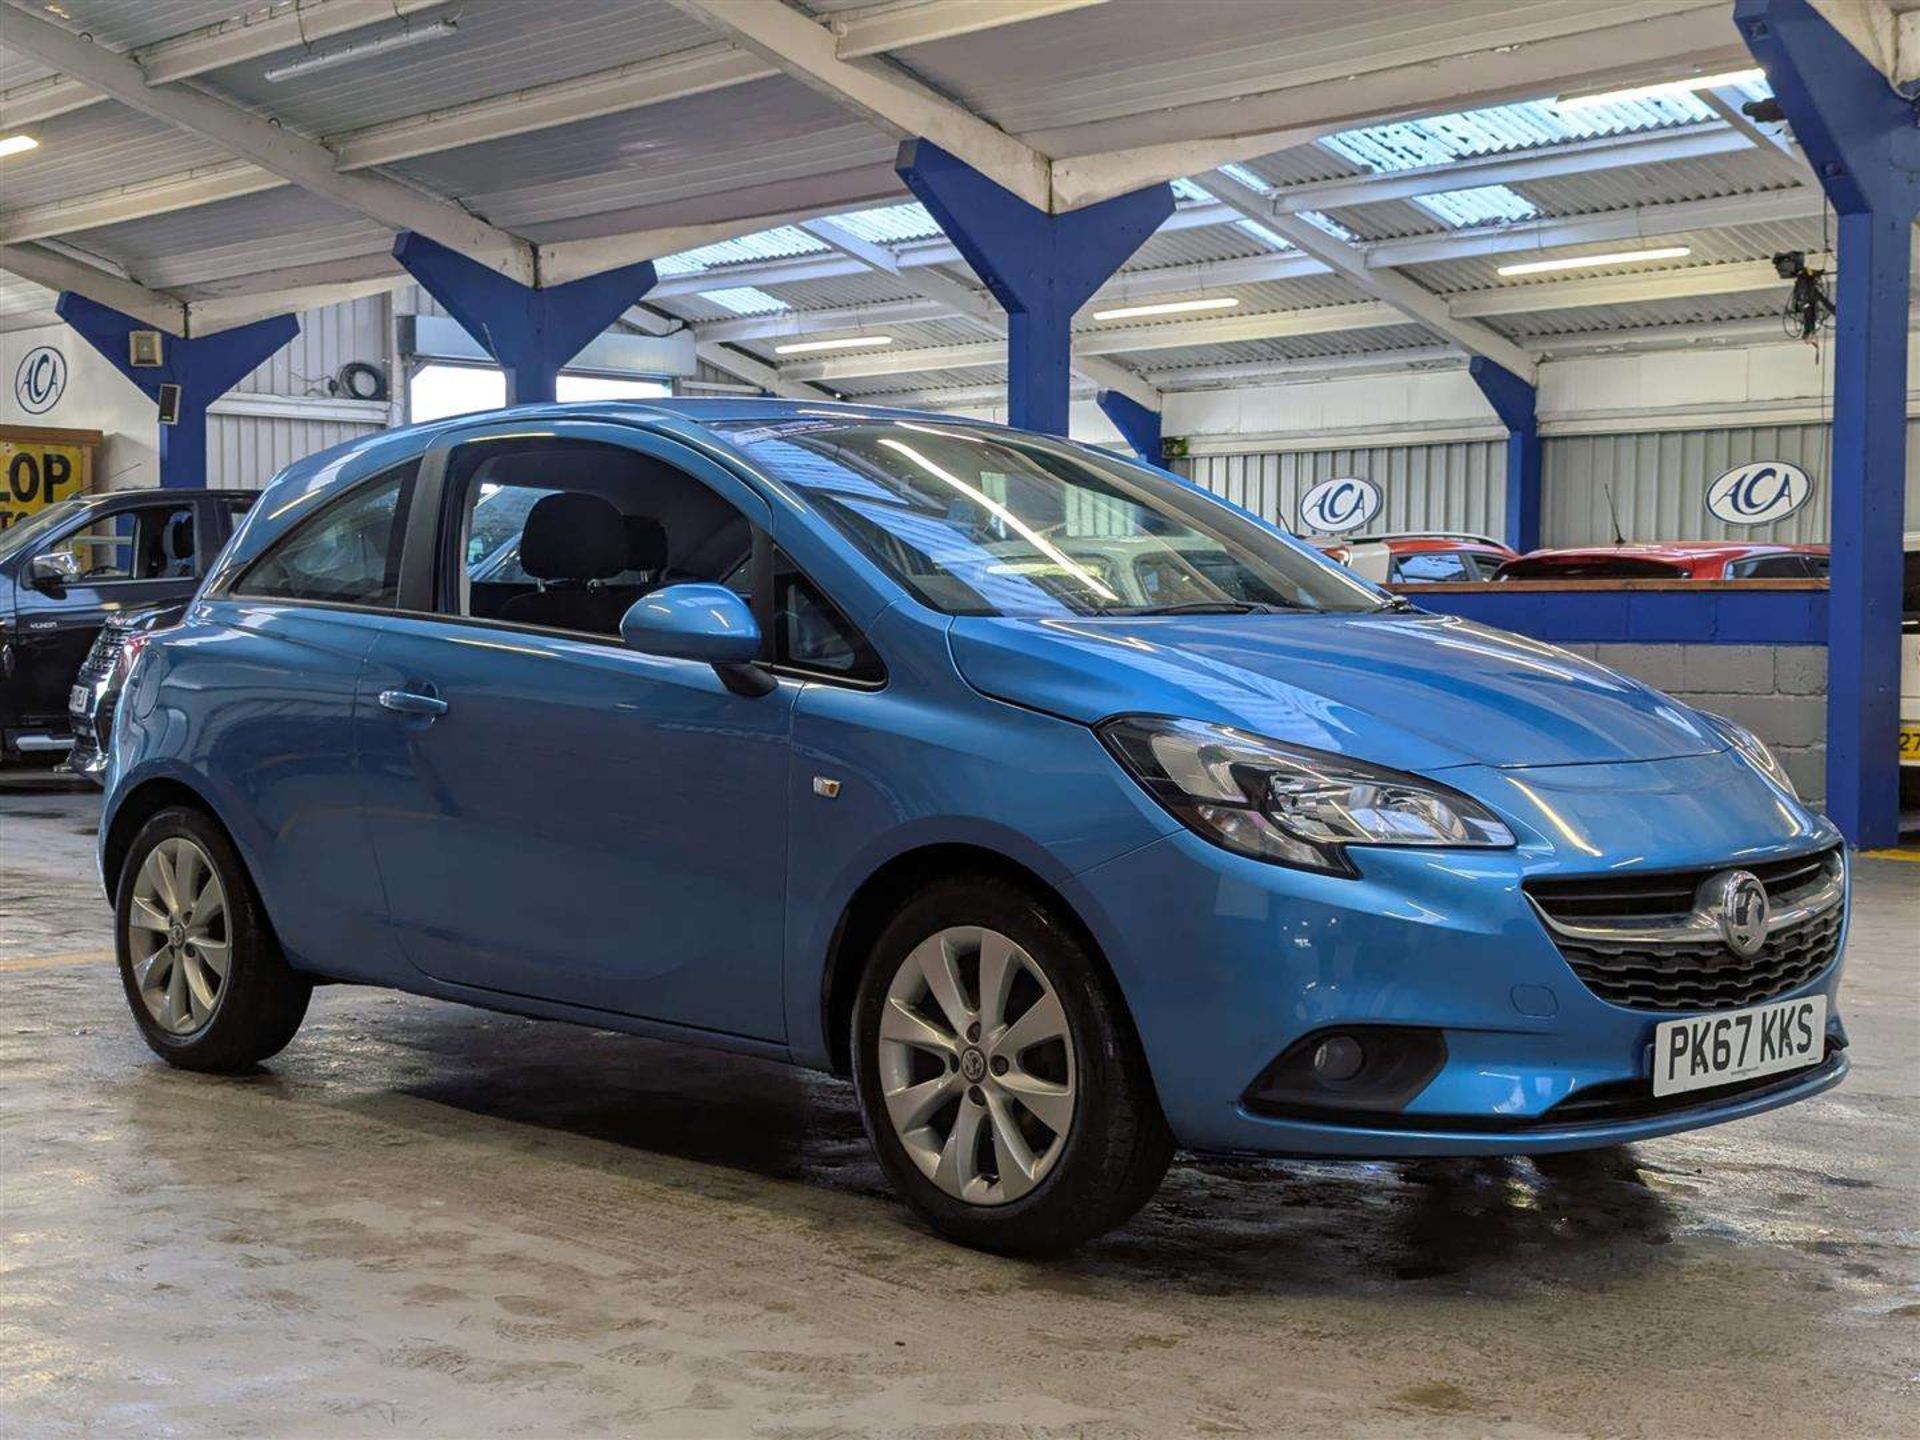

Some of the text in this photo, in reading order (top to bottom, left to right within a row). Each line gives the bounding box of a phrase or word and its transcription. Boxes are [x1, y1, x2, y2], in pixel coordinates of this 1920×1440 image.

[19, 354, 58, 404] ACA
[1304, 483, 1365, 524] ACA
[1712, 467, 1793, 515] ACA
[1668, 1003, 1813, 1080] PK67 KKS
